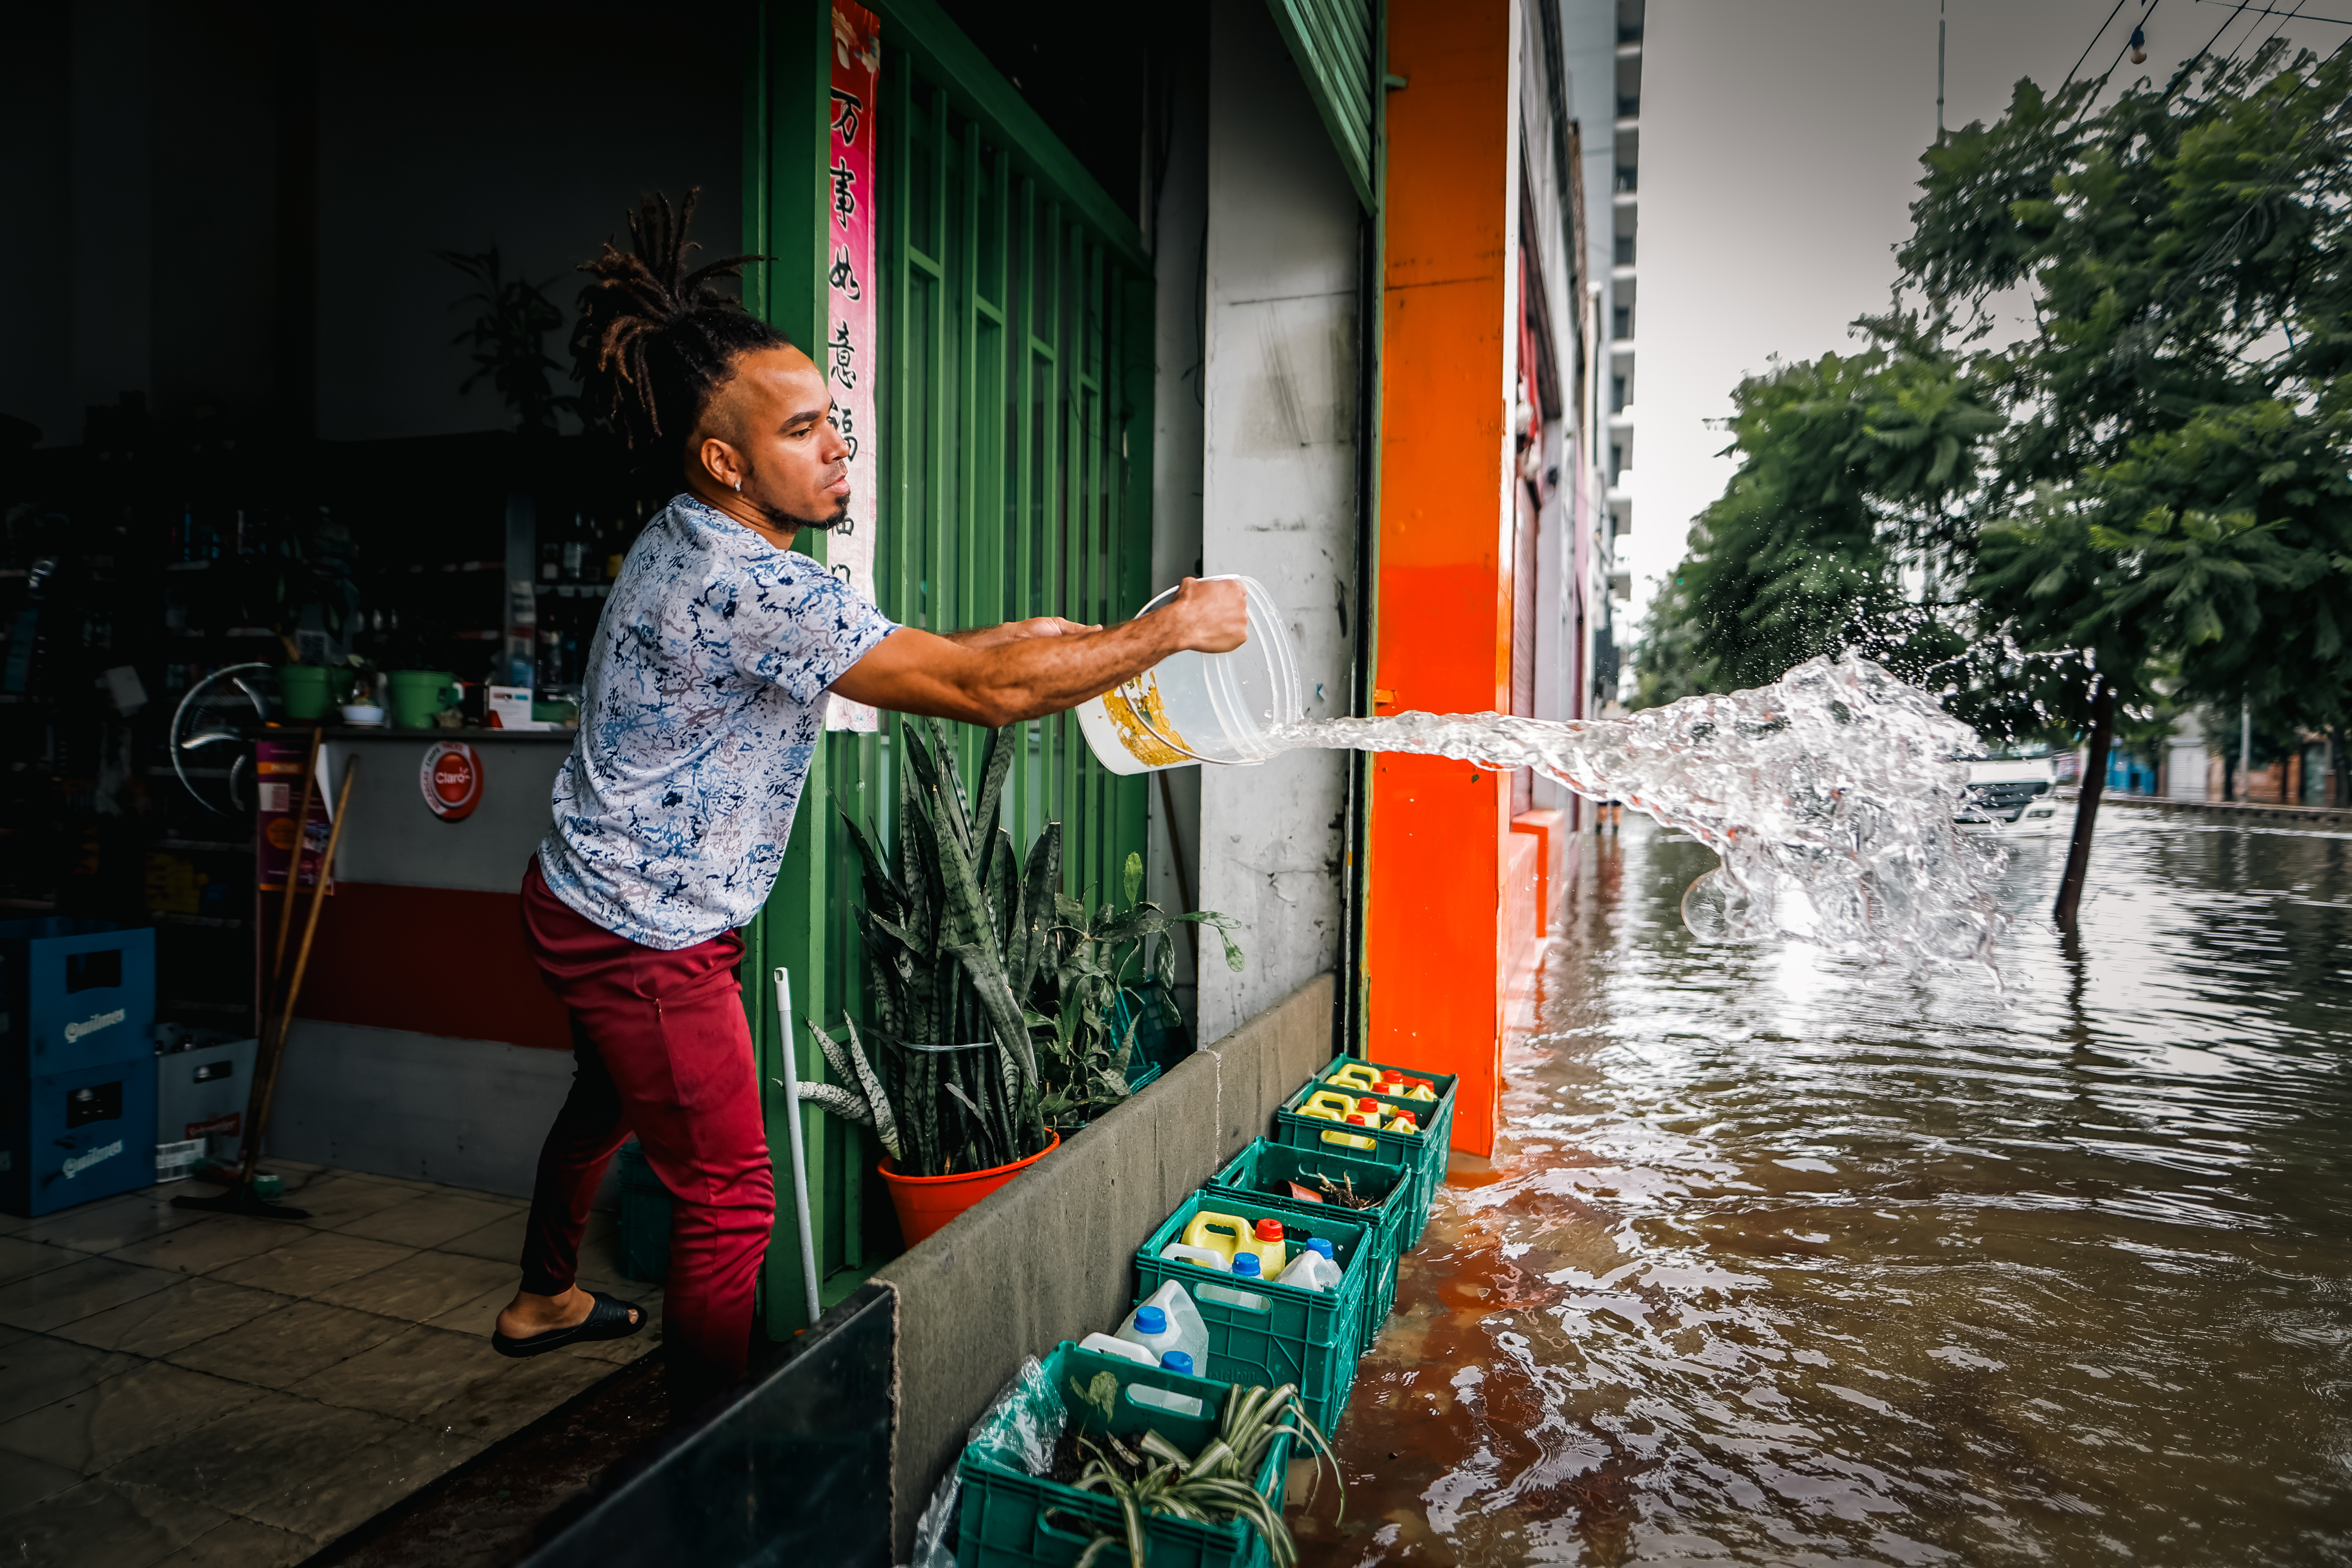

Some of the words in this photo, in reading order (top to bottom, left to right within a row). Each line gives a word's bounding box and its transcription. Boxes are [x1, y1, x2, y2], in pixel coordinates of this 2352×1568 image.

[436, 771, 465, 784] Claro
[65, 1009, 125, 1043] Quilmes
[63, 1140, 122, 1179] Quilmes
